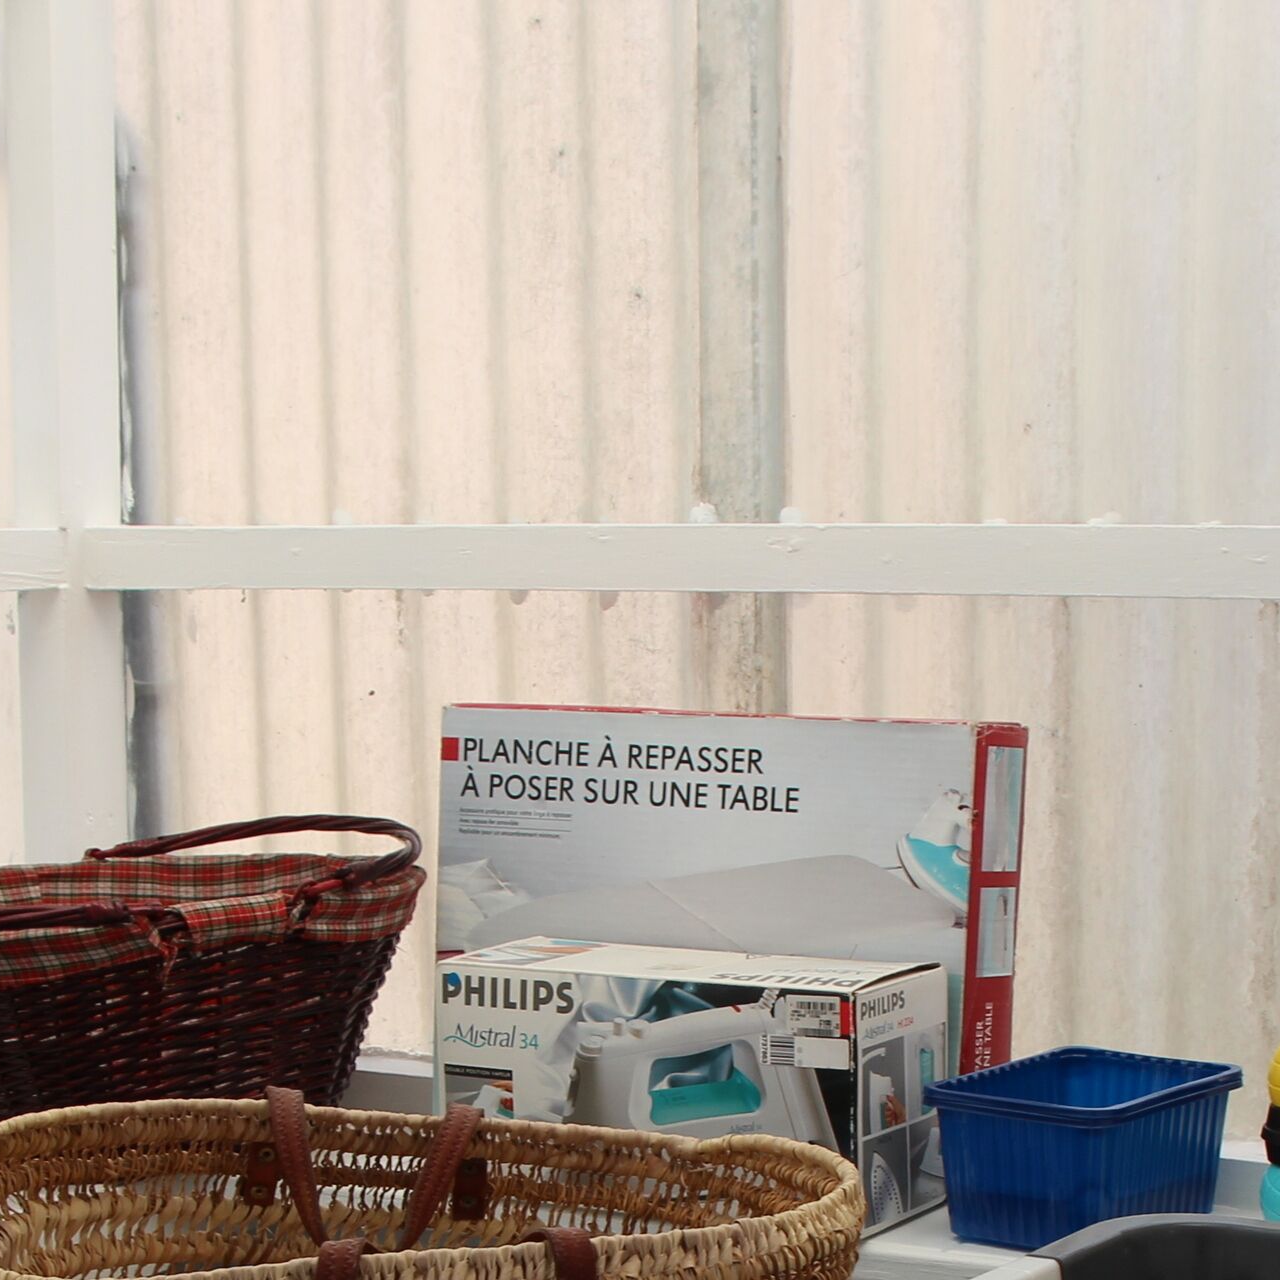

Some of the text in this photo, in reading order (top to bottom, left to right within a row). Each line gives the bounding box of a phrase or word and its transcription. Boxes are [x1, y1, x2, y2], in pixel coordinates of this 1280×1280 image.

[463, 735, 763, 774] PLANCHE À REPASSER
[460, 765, 800, 813] À POSER SUR UNE TABLE
[442, 972, 574, 1014] PHILIPS
[711, 973, 865, 988] PHILIPS
[861, 990, 905, 1021] PHILIPS
[985, 1002, 993, 1041] TABLE
[455, 1023, 539, 1050] Mistral 34
